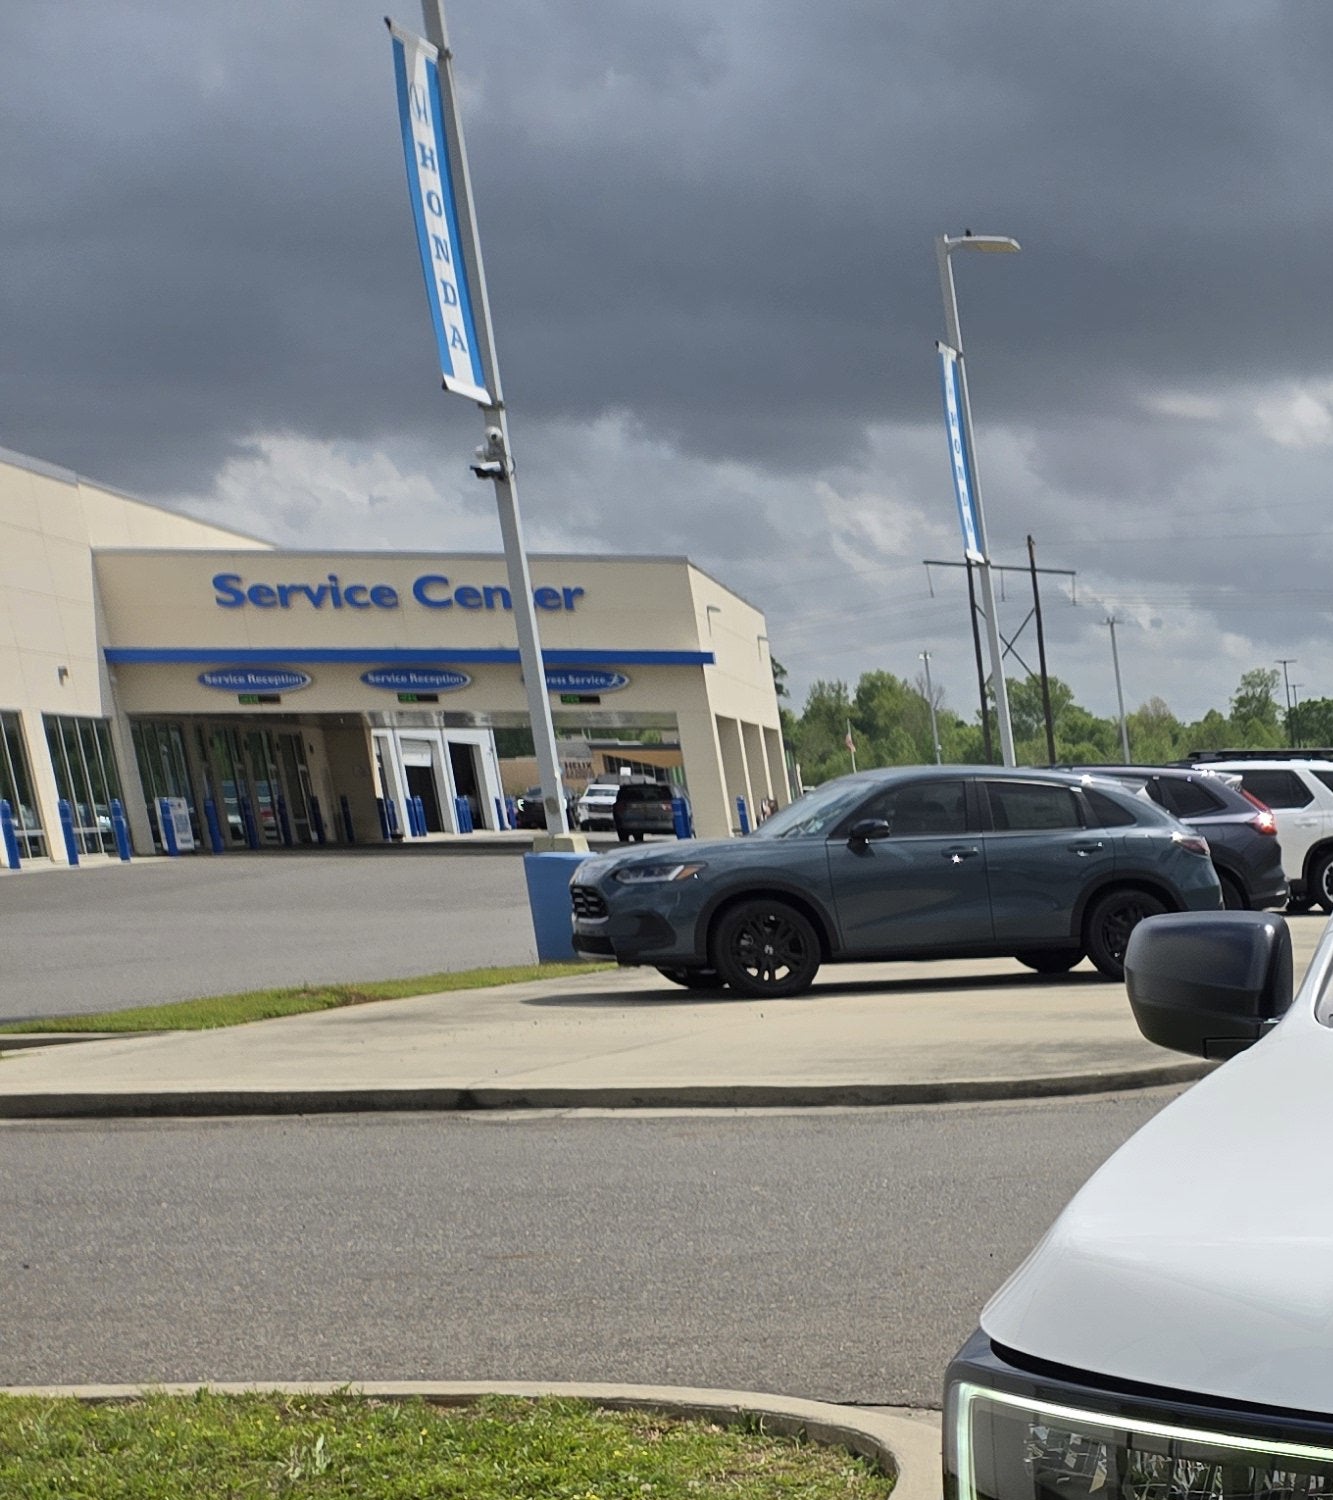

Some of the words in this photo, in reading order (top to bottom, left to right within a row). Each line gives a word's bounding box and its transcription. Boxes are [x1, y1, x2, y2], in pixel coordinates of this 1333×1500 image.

[417, 141, 467, 354] HONDA
[212, 573, 399, 610] Service
[412, 574, 585, 612] Cener
[204, 673, 245, 685] Service
[247, 673, 303, 686] Reception
[367, 673, 408, 684] Service
[409, 672, 464, 686] Reception
